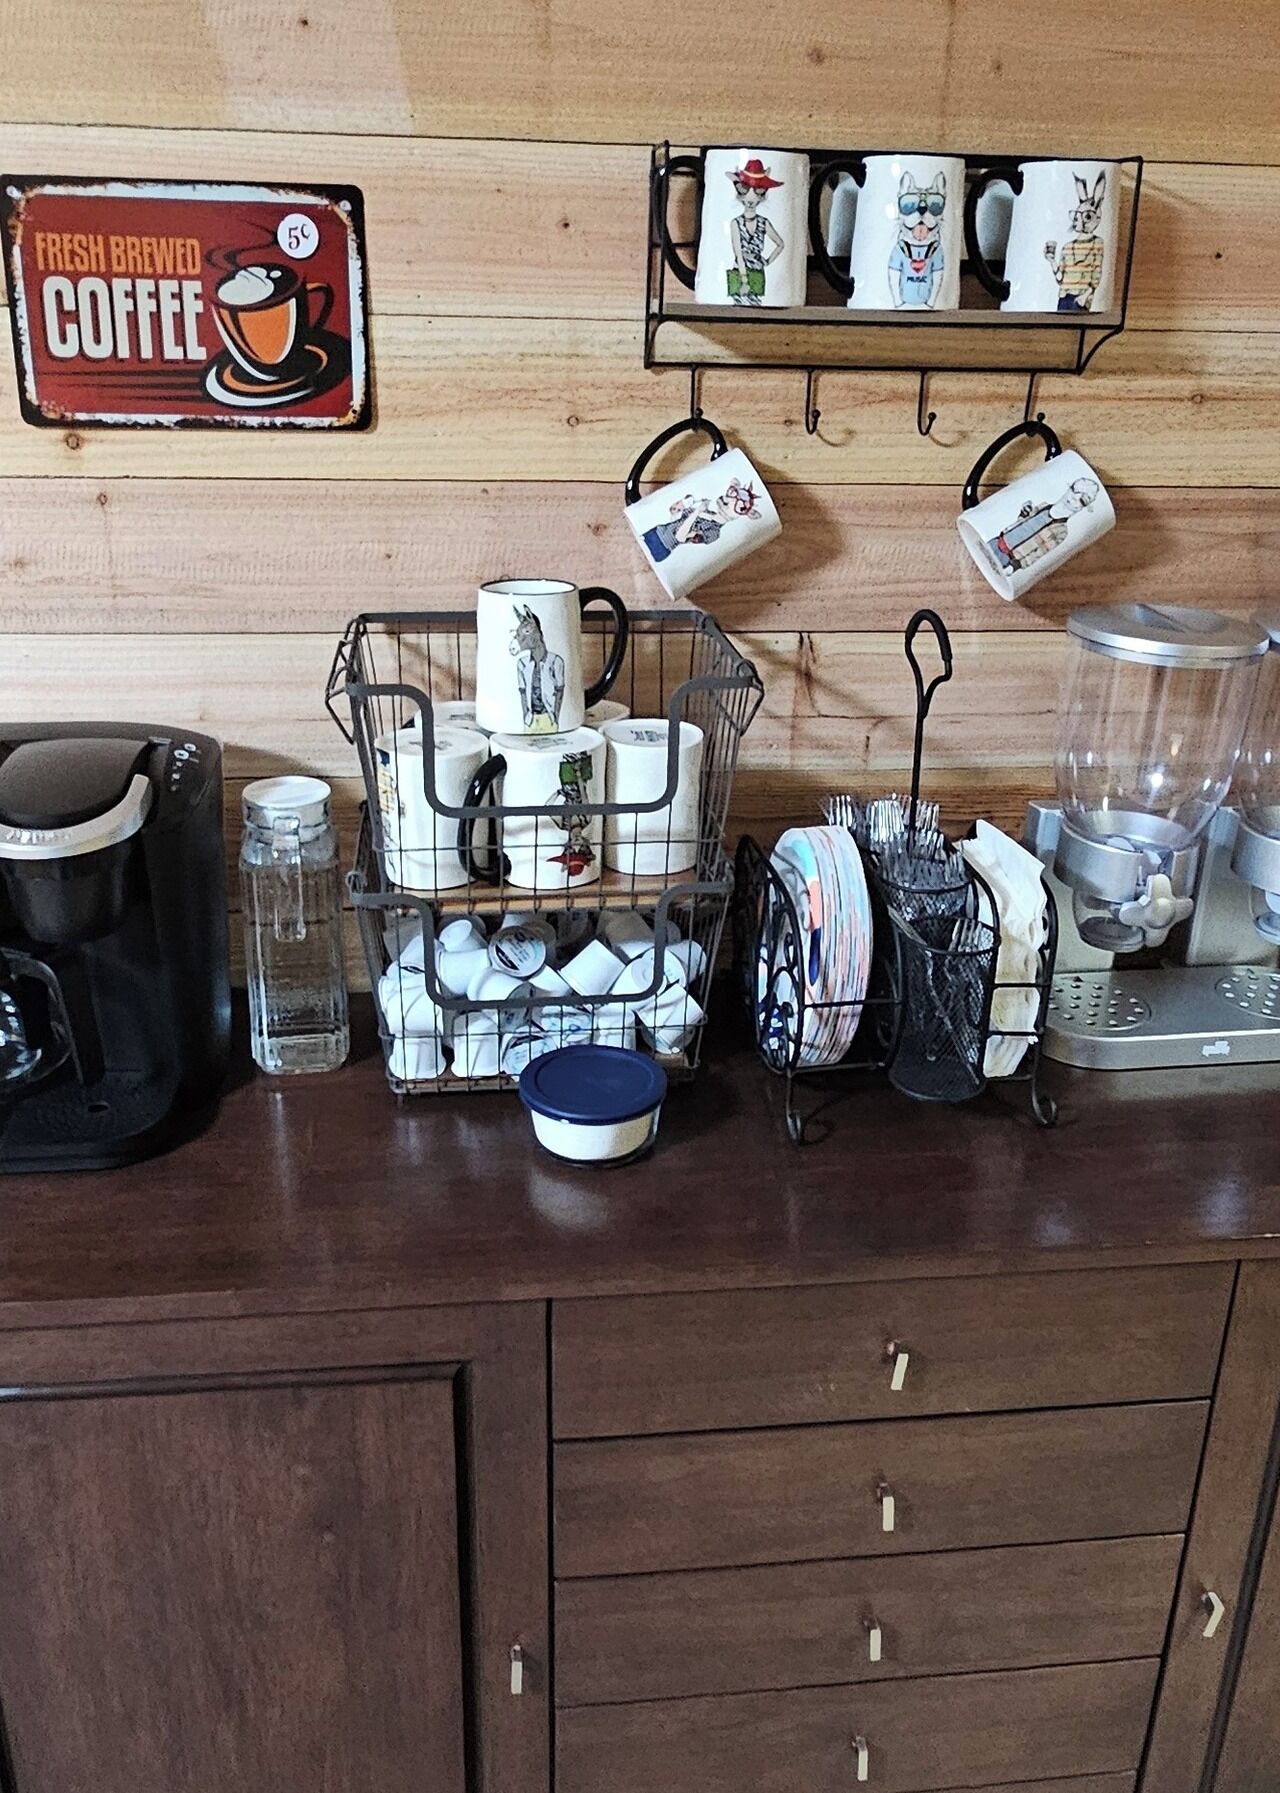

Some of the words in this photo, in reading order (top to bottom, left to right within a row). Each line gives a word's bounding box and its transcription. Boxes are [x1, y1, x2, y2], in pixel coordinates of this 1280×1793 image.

[35, 232, 106, 272] FRESH
[109, 235, 202, 275] BREWED
[42, 276, 207, 361] COFFEE
